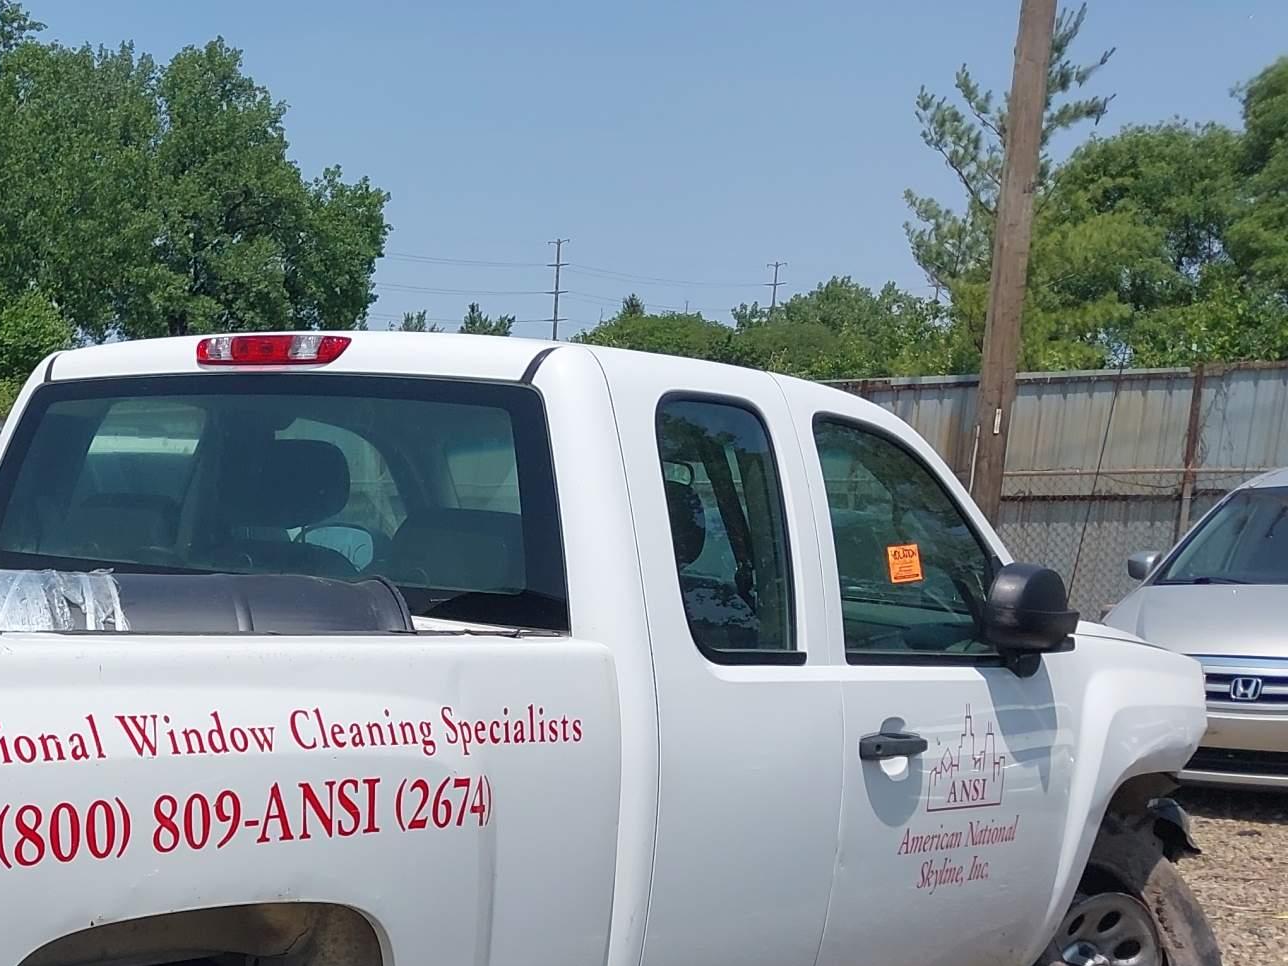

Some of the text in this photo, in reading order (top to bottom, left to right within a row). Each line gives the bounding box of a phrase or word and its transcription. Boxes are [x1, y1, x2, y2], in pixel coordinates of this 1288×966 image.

[114, 710, 276, 758] Window
[289, 707, 437, 757] Cleaning
[440, 703, 583, 756] Specialists
[946, 777, 988, 803] ANSI
[151, 777, 381, 854] 809-ANSI
[394, 774, 493, 832] (2674)
[897, 814, 1020, 856] American National
[916, 855, 990, 895] Skyline, Inc.
